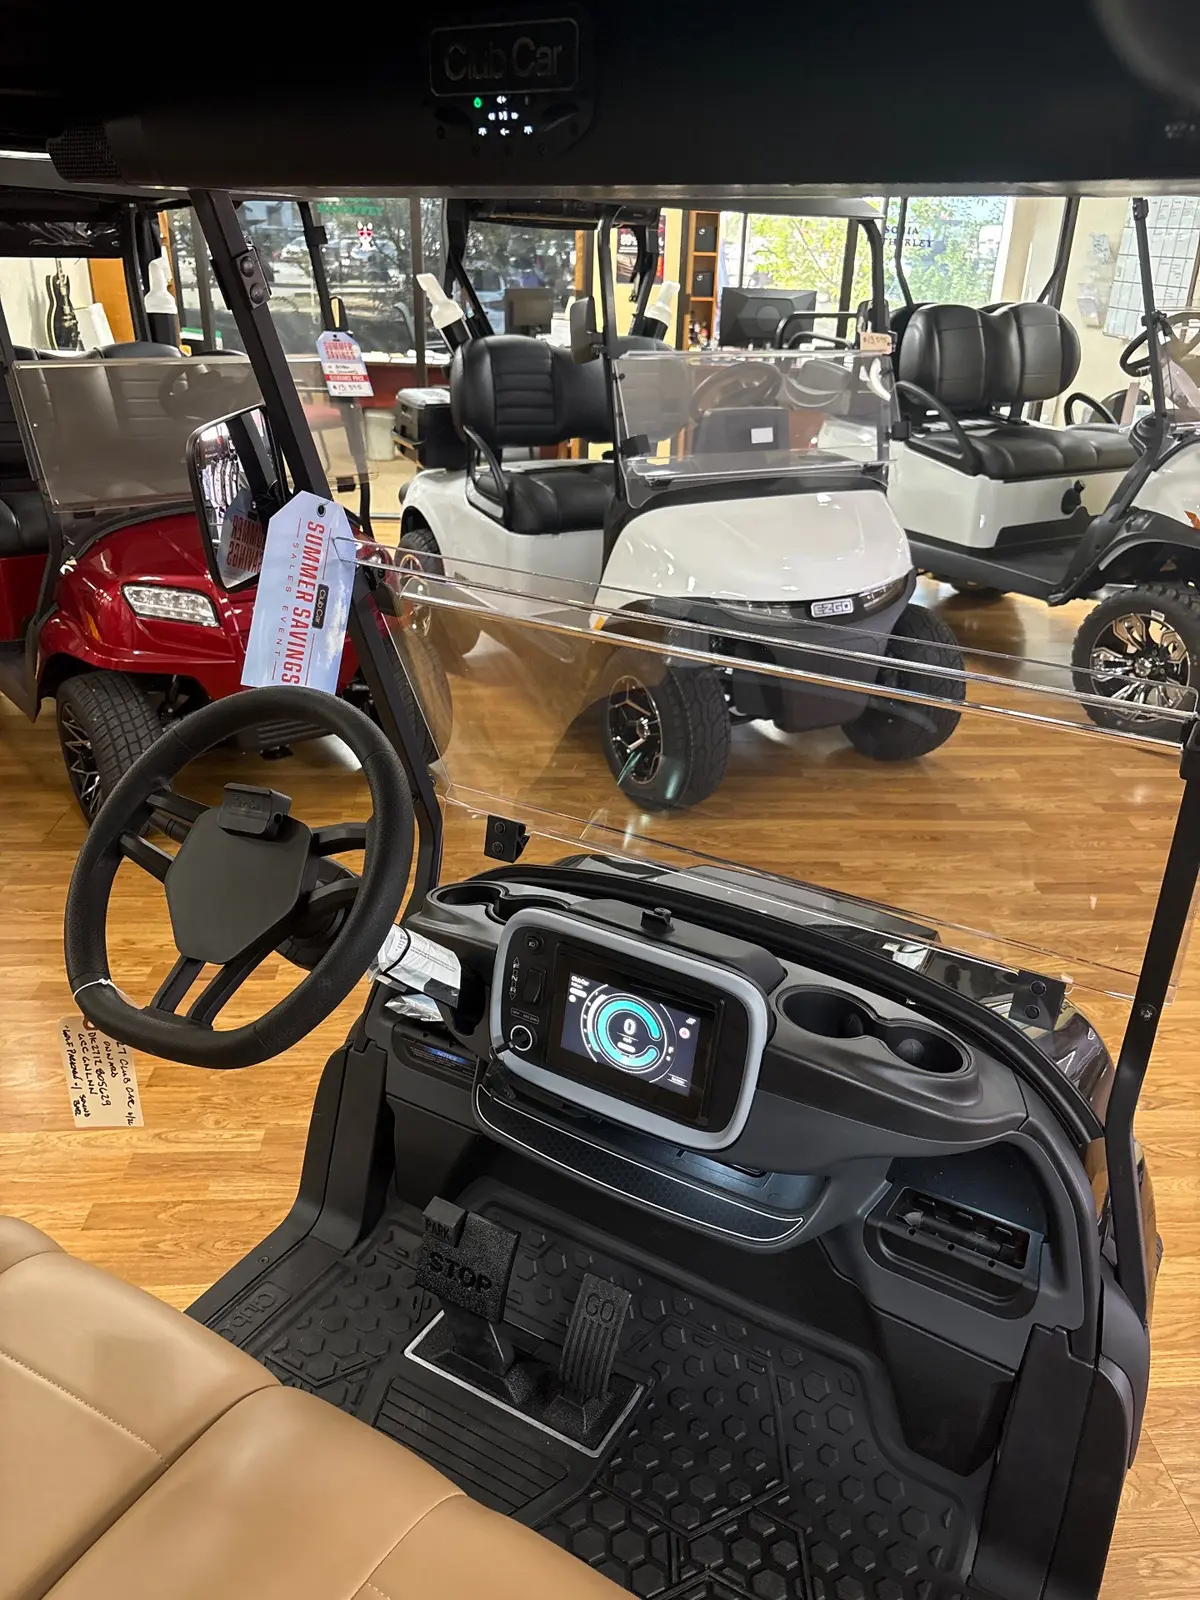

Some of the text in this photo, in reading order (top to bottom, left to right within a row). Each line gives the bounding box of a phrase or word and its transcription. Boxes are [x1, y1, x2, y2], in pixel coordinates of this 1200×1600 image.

[444, 36, 564, 81] Club Car
[274, 542, 300, 657] SALES EVENT
[281, 520, 325, 685] SUMMER SAVINGS
[313, 588, 328, 625] Club Car
[623, 1018, 636, 1035] 0
[103, 1040, 118, 1078] ONWARD
[119, 1058, 131, 1084] CLUB
[425, 1217, 450, 1241] PARK
[428, 1251, 492, 1293] STOP
[231, 1293, 276, 1328] Club
[585, 1292, 615, 1322] GO
